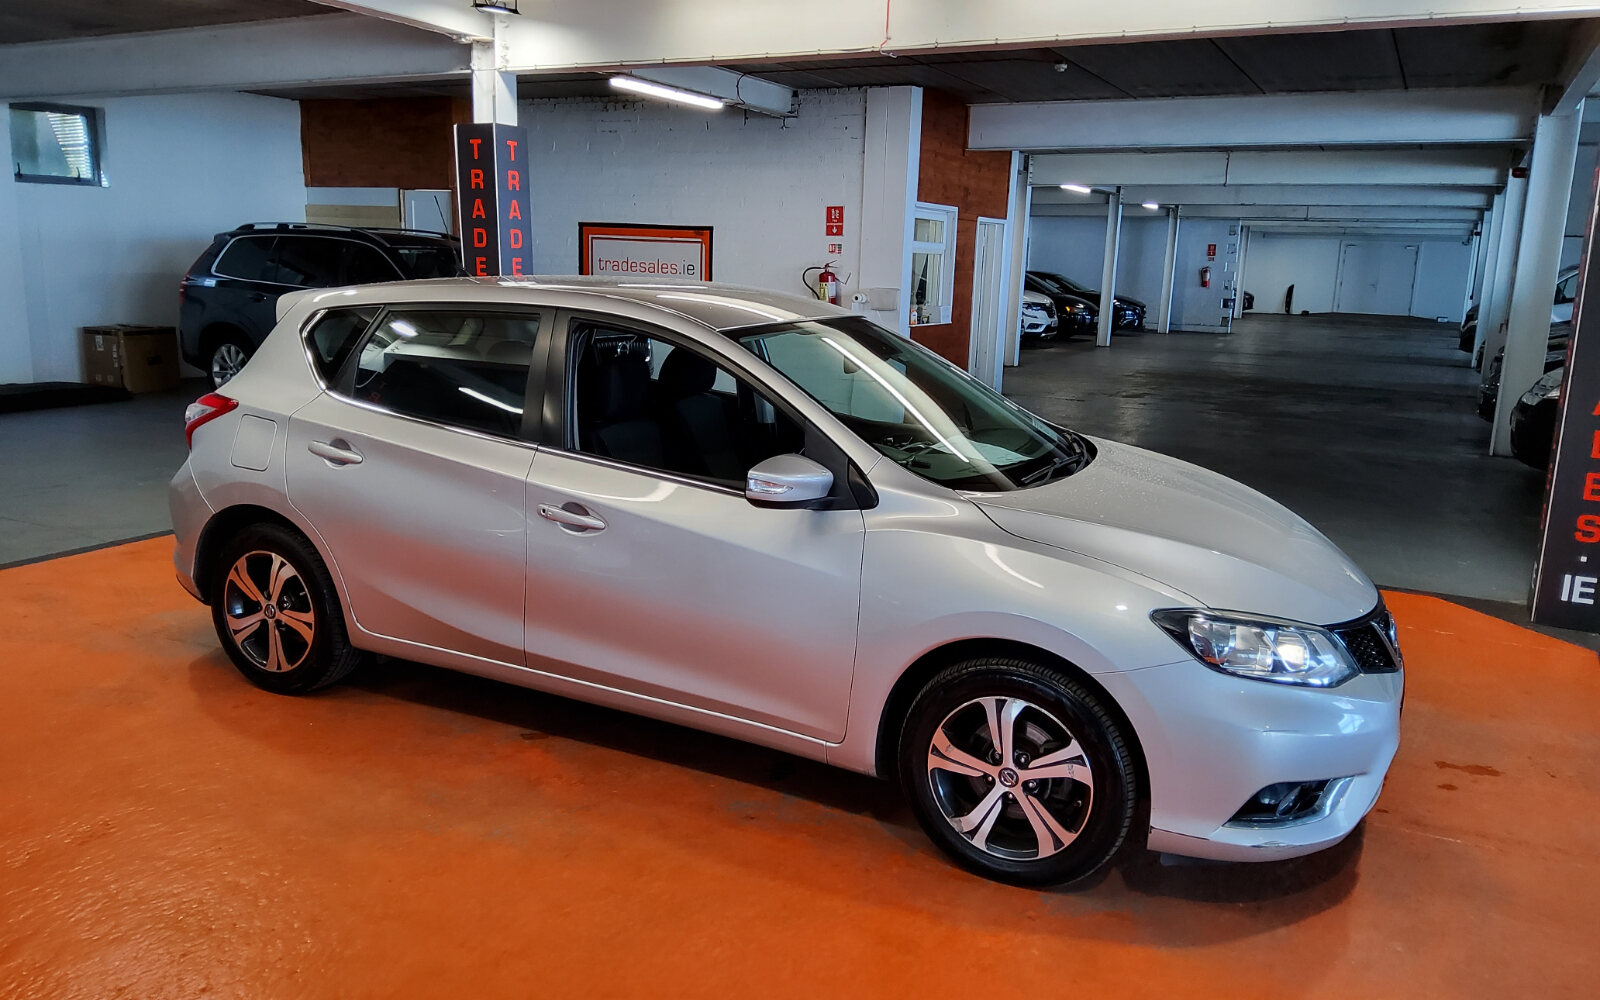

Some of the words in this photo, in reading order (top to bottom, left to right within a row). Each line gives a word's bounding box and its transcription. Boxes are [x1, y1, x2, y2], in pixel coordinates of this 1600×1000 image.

[469, 138, 488, 277] TRADE
[506, 140, 524, 277] TRADE
[598, 256, 695, 275] tradesales.ie
